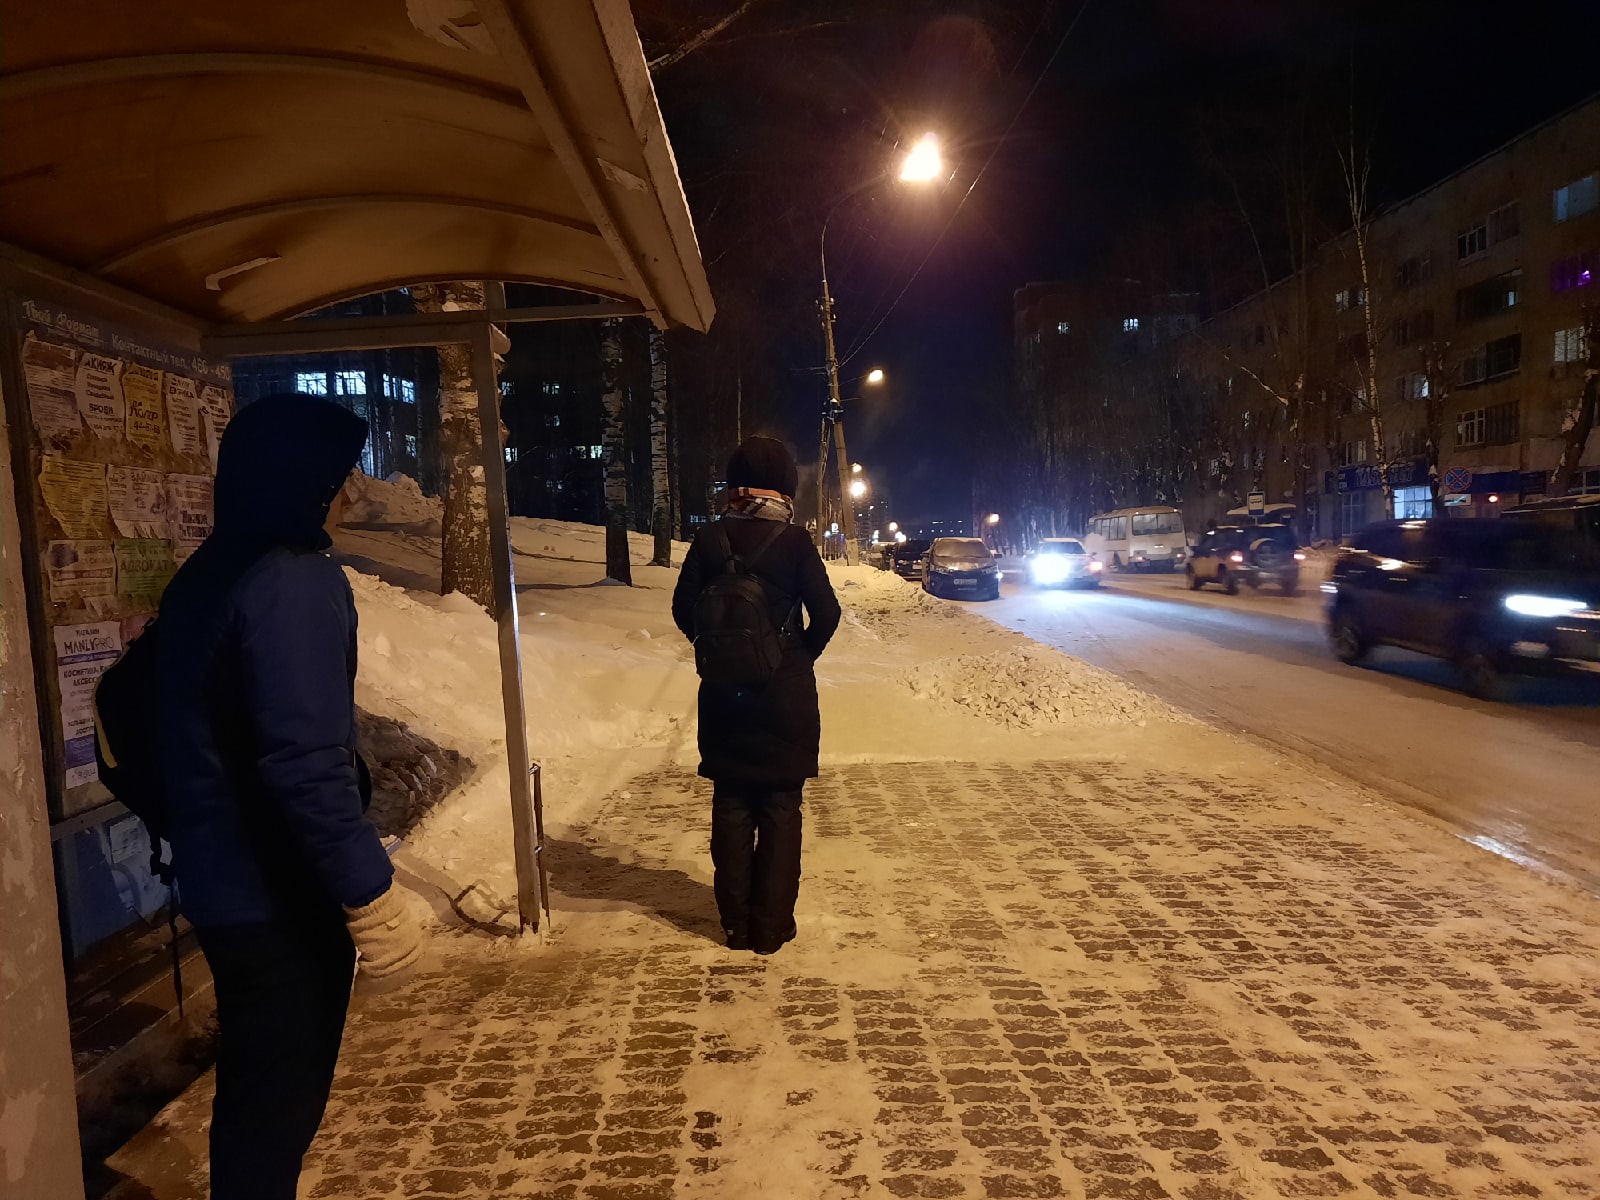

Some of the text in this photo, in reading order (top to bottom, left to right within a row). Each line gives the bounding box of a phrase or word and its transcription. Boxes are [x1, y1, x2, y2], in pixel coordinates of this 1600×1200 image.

[22, 300, 51, 323] Твой
[191, 356, 208, 374] 466
[118, 560, 169, 576] АДВОКАТ
